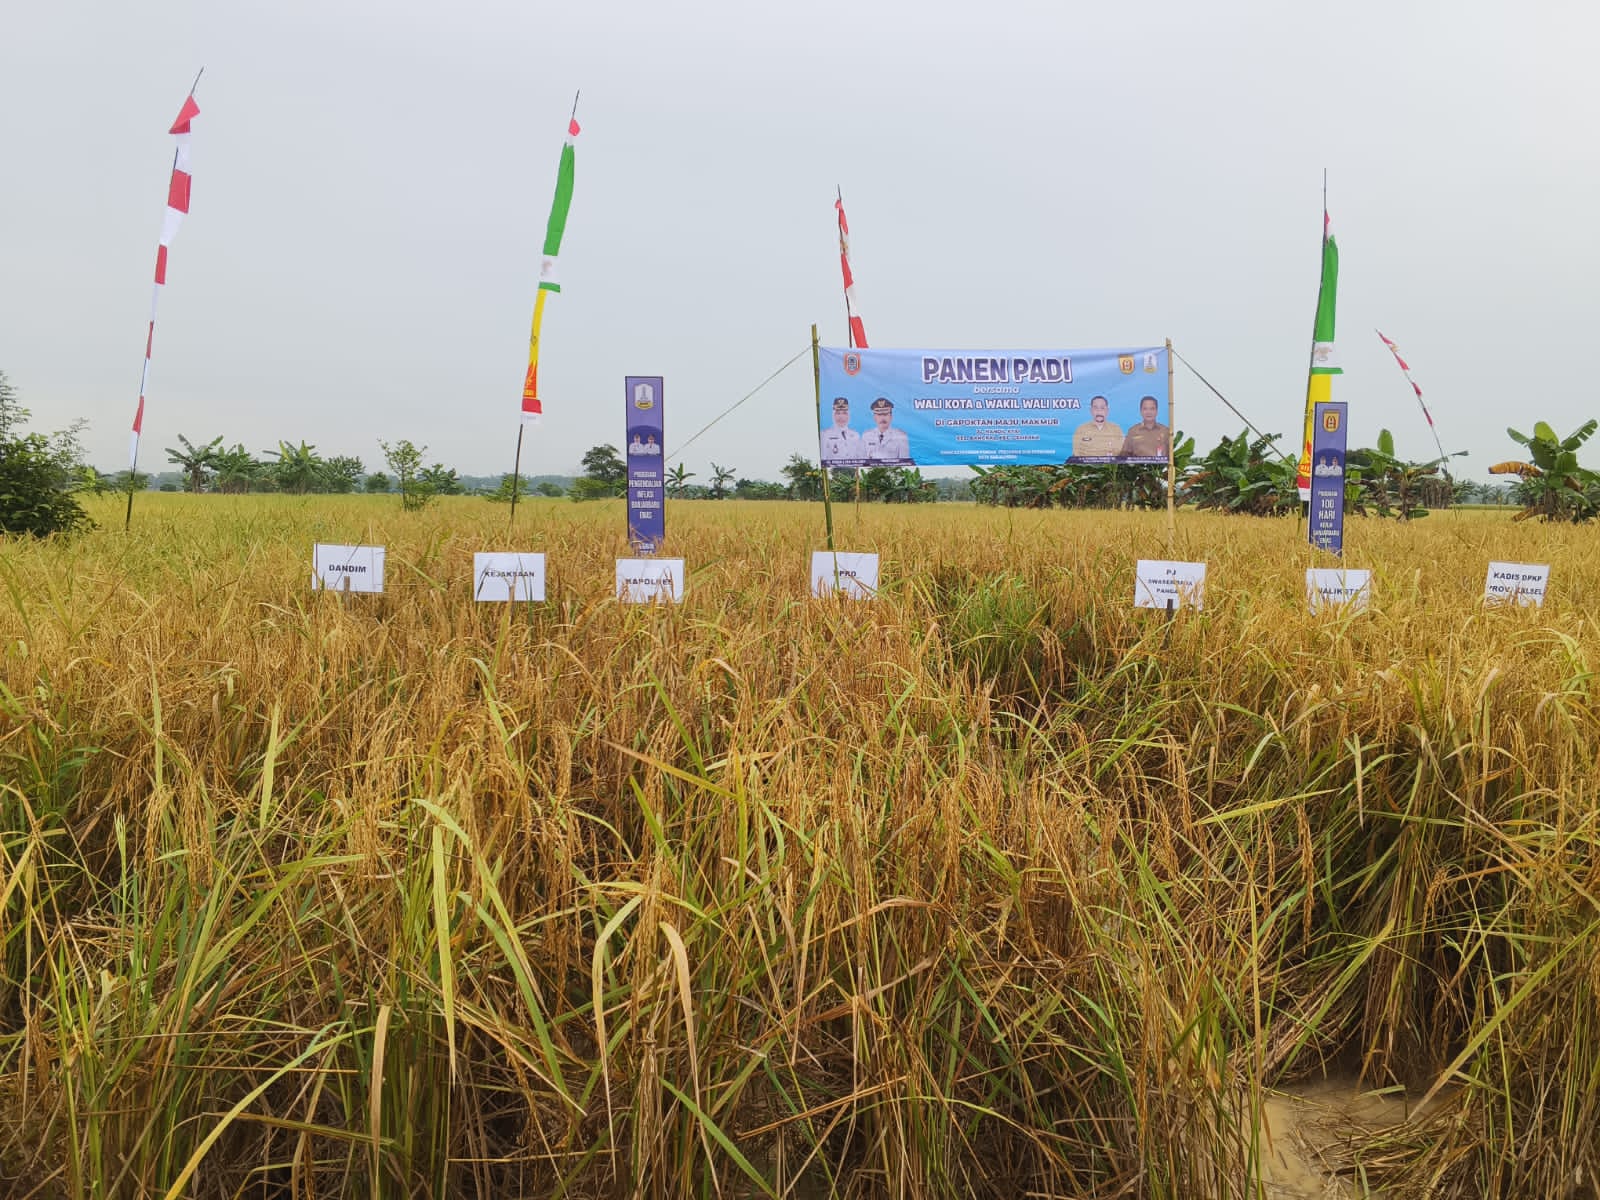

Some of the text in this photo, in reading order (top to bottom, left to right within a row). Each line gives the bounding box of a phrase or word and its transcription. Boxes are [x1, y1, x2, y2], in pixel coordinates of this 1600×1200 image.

[922, 356, 1073, 383] PANEN PADI
[973, 384, 1020, 394] bersama
[914, 399, 1081, 410] WALI KOTA & WAKIL WALI KOTA
[1021, 418, 1059, 426] MAKMUR
[1321, 499, 1335, 509] 100
[1318, 510, 1336, 520] HARI
[328, 564, 367, 573] DANDIM
[1493, 572, 1542, 582] KADIS DPKP
